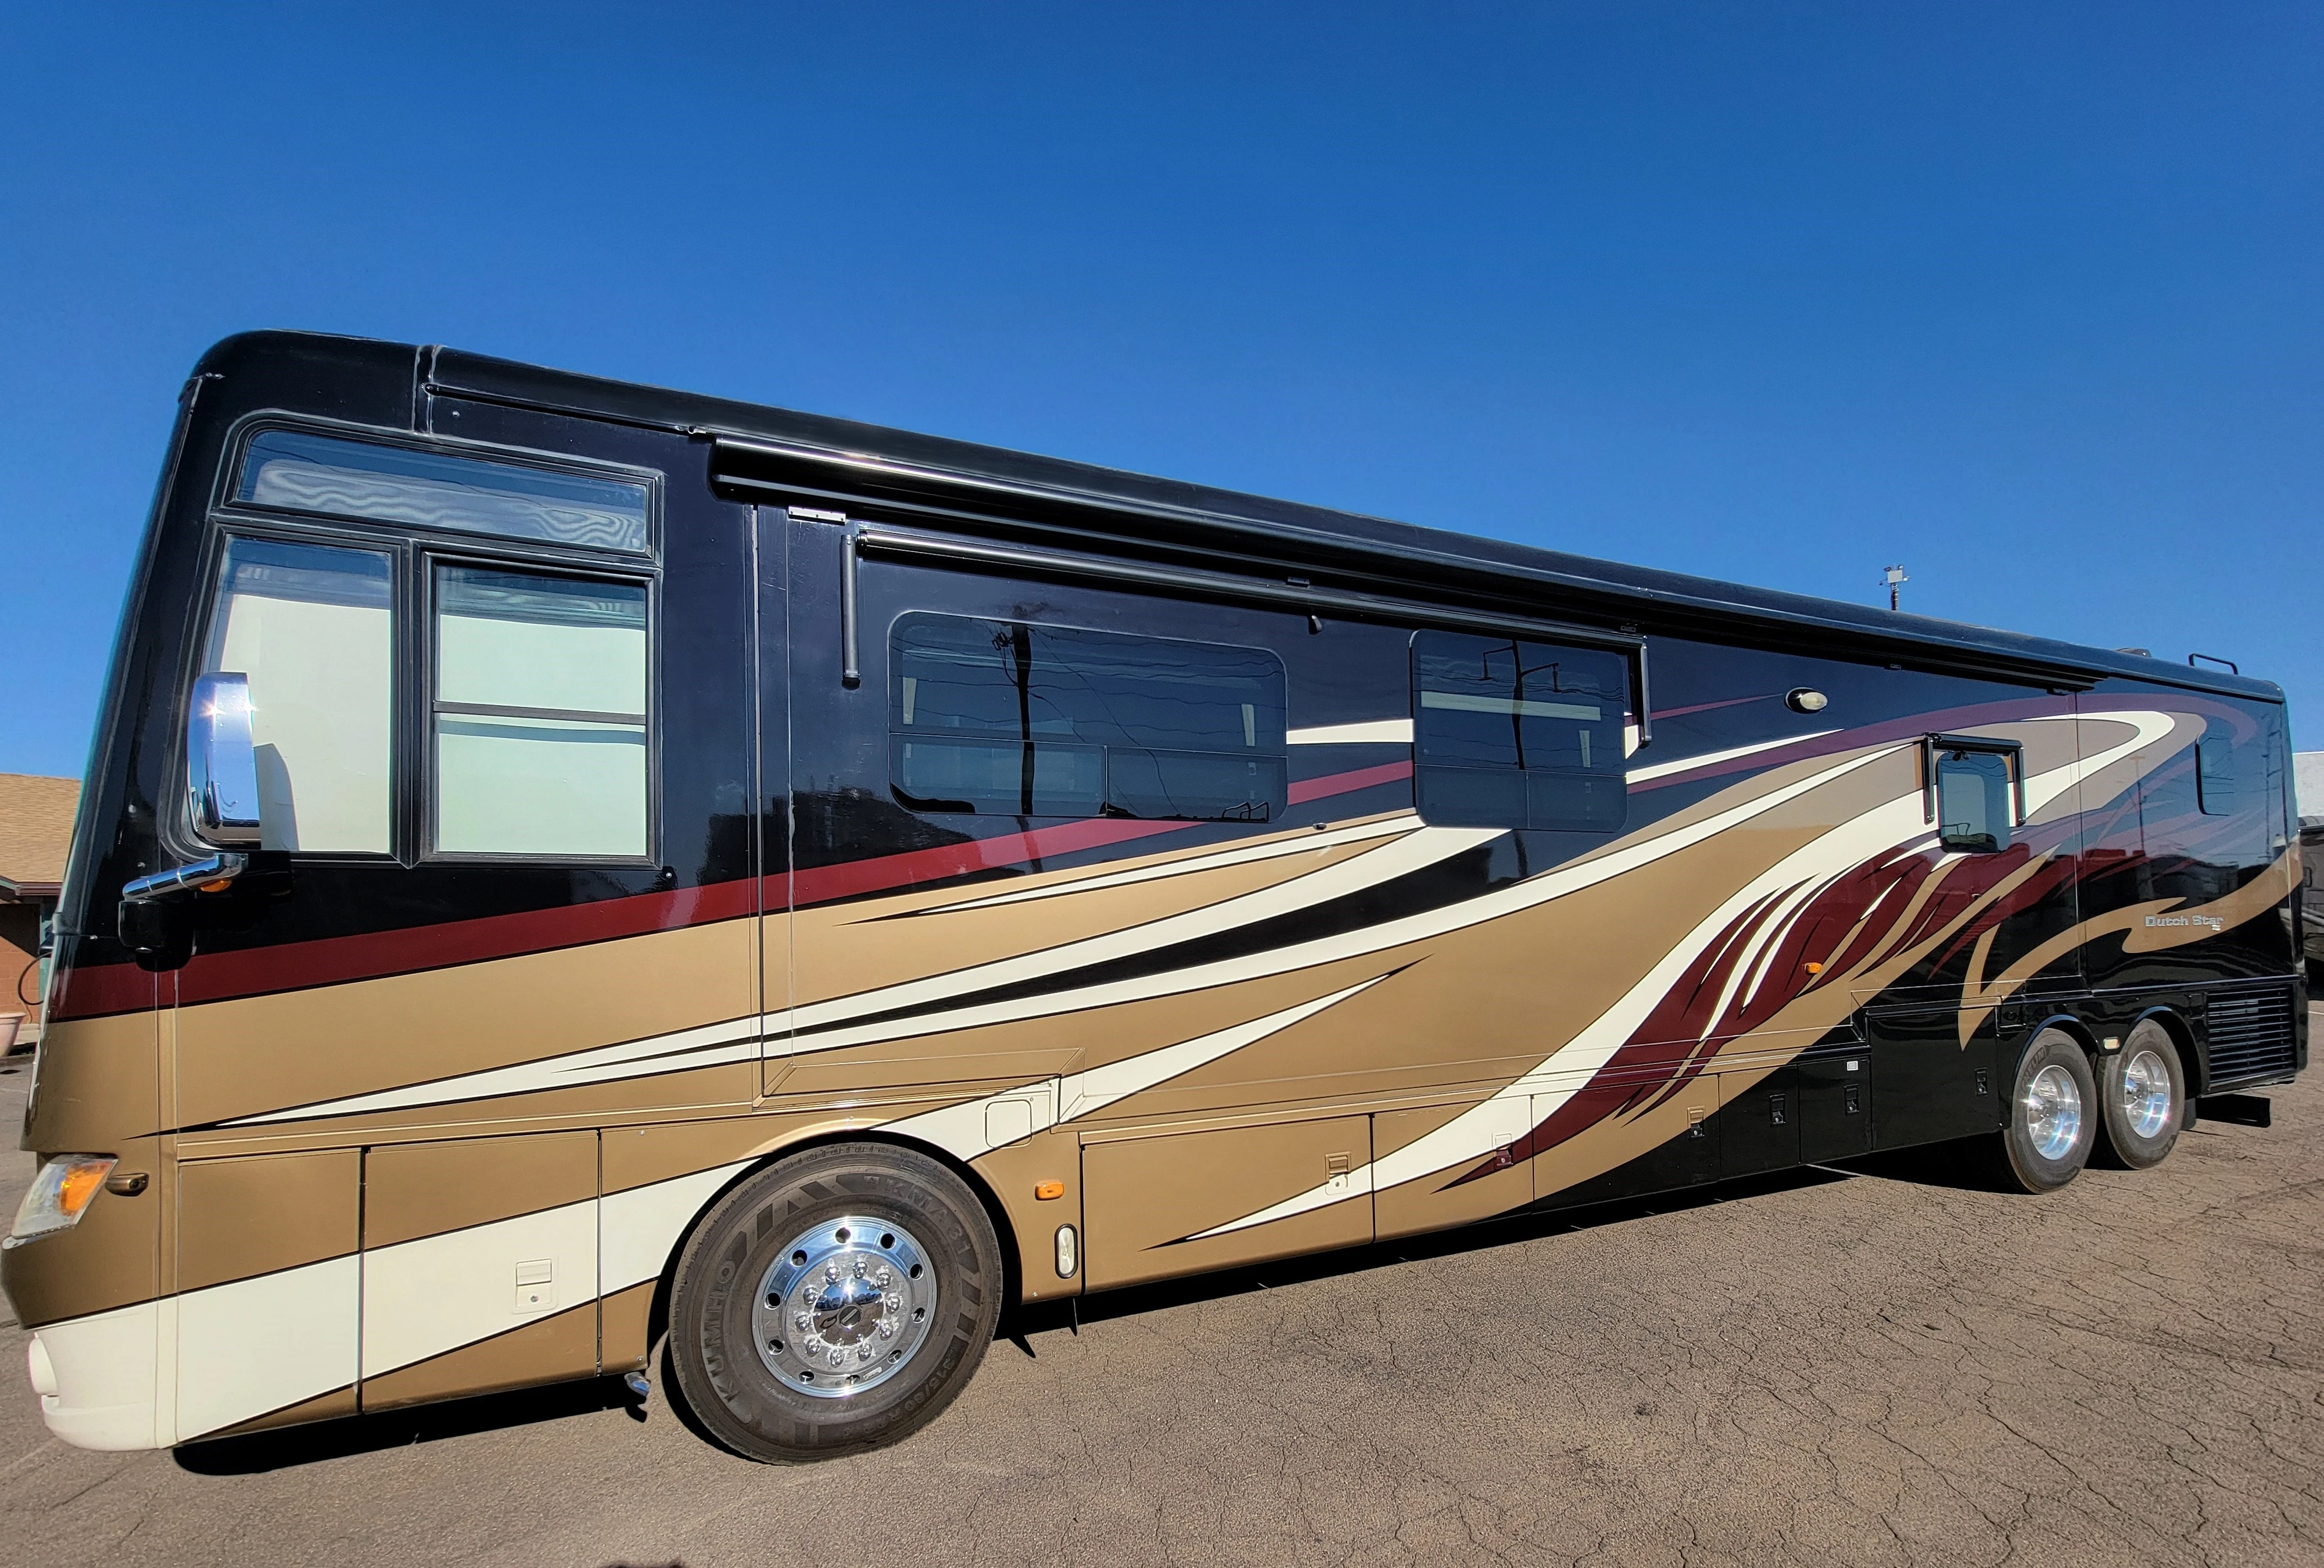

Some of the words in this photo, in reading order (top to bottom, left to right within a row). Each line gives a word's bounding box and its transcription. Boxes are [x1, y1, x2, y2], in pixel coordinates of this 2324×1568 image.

[2145, 916, 2189, 927] Dutch
[2193, 915, 2223, 925] Star
[704, 1260, 741, 1403] KUMHO
